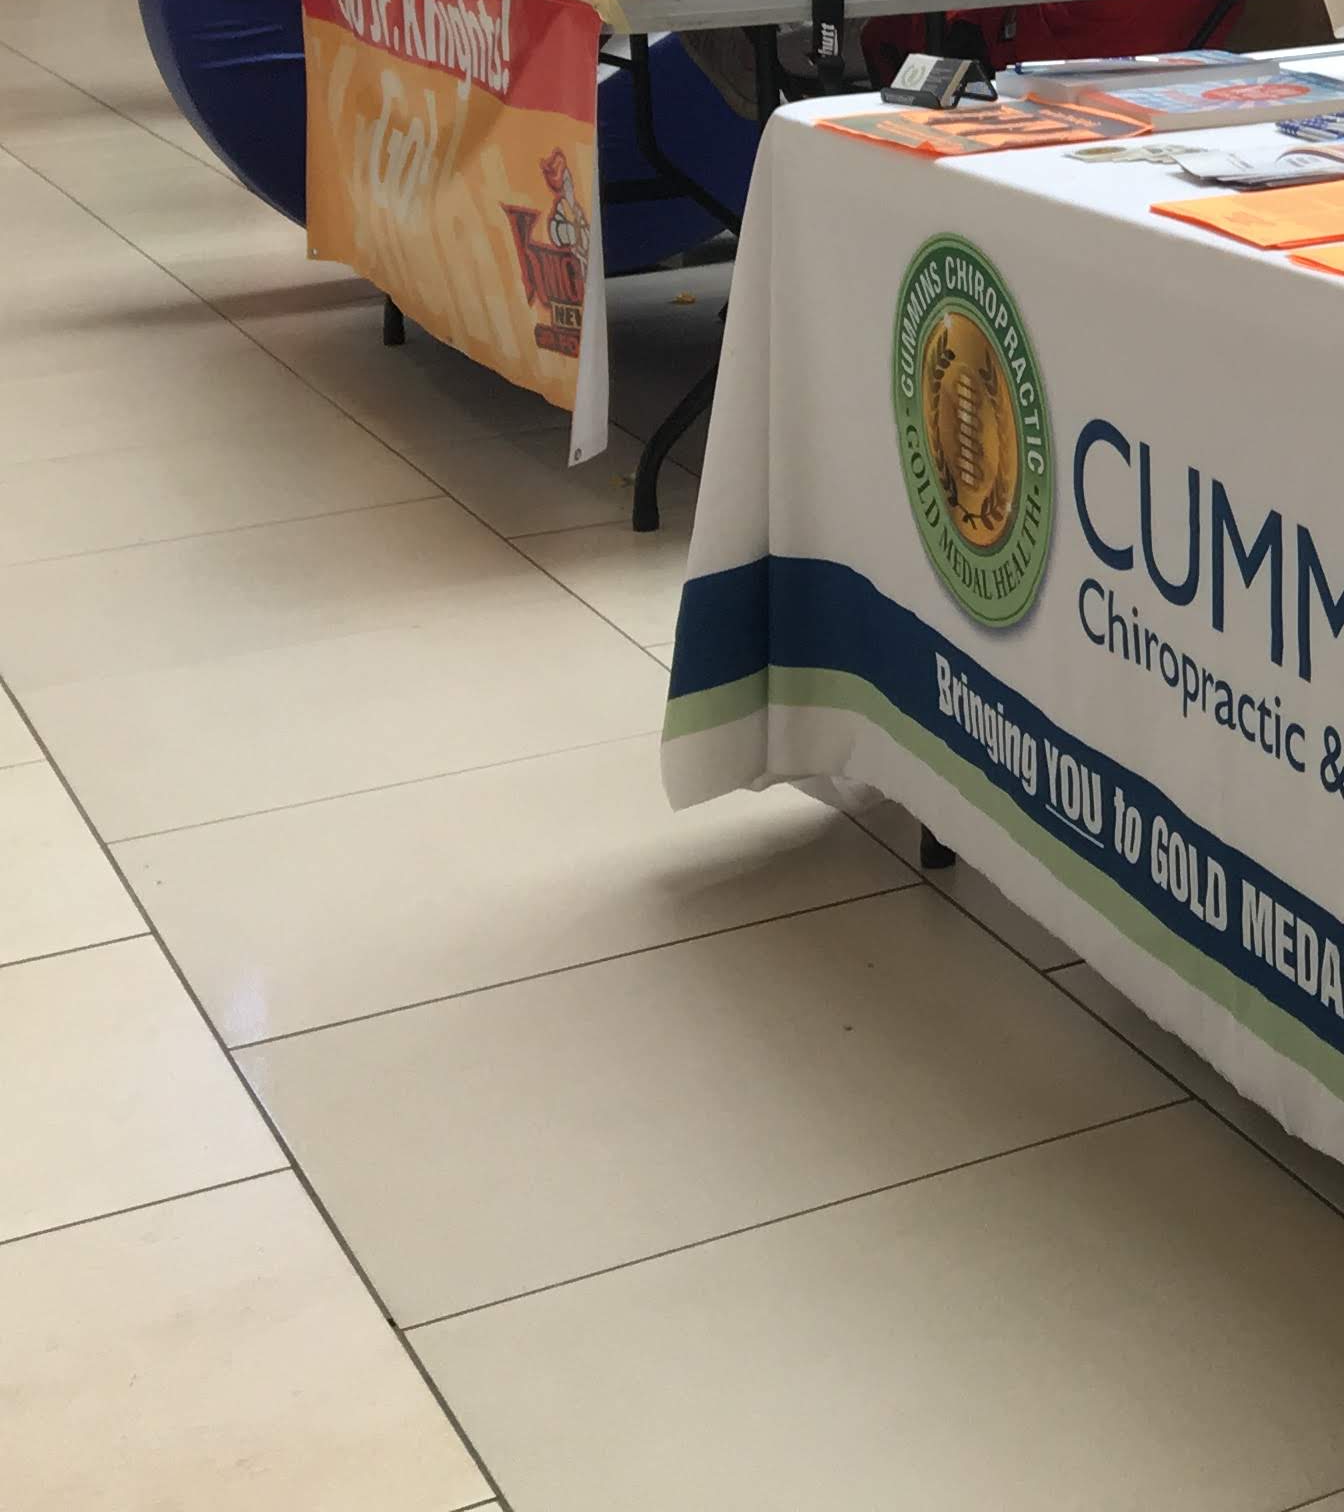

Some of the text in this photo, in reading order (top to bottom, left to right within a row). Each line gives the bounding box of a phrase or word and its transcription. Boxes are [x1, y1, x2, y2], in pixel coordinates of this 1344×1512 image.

[901, 256, 1045, 476] CUMMINS CHIROPRACTIC
[905, 422, 1042, 601] GOLD MEDAL HEALTH
[1079, 577, 1305, 773] Chiropractic
[935, 651, 1039, 797] Bringing
[1045, 738, 1103, 841] YOU
[1115, 786, 1140, 866] to
[1150, 806, 1228, 934] GOLD
